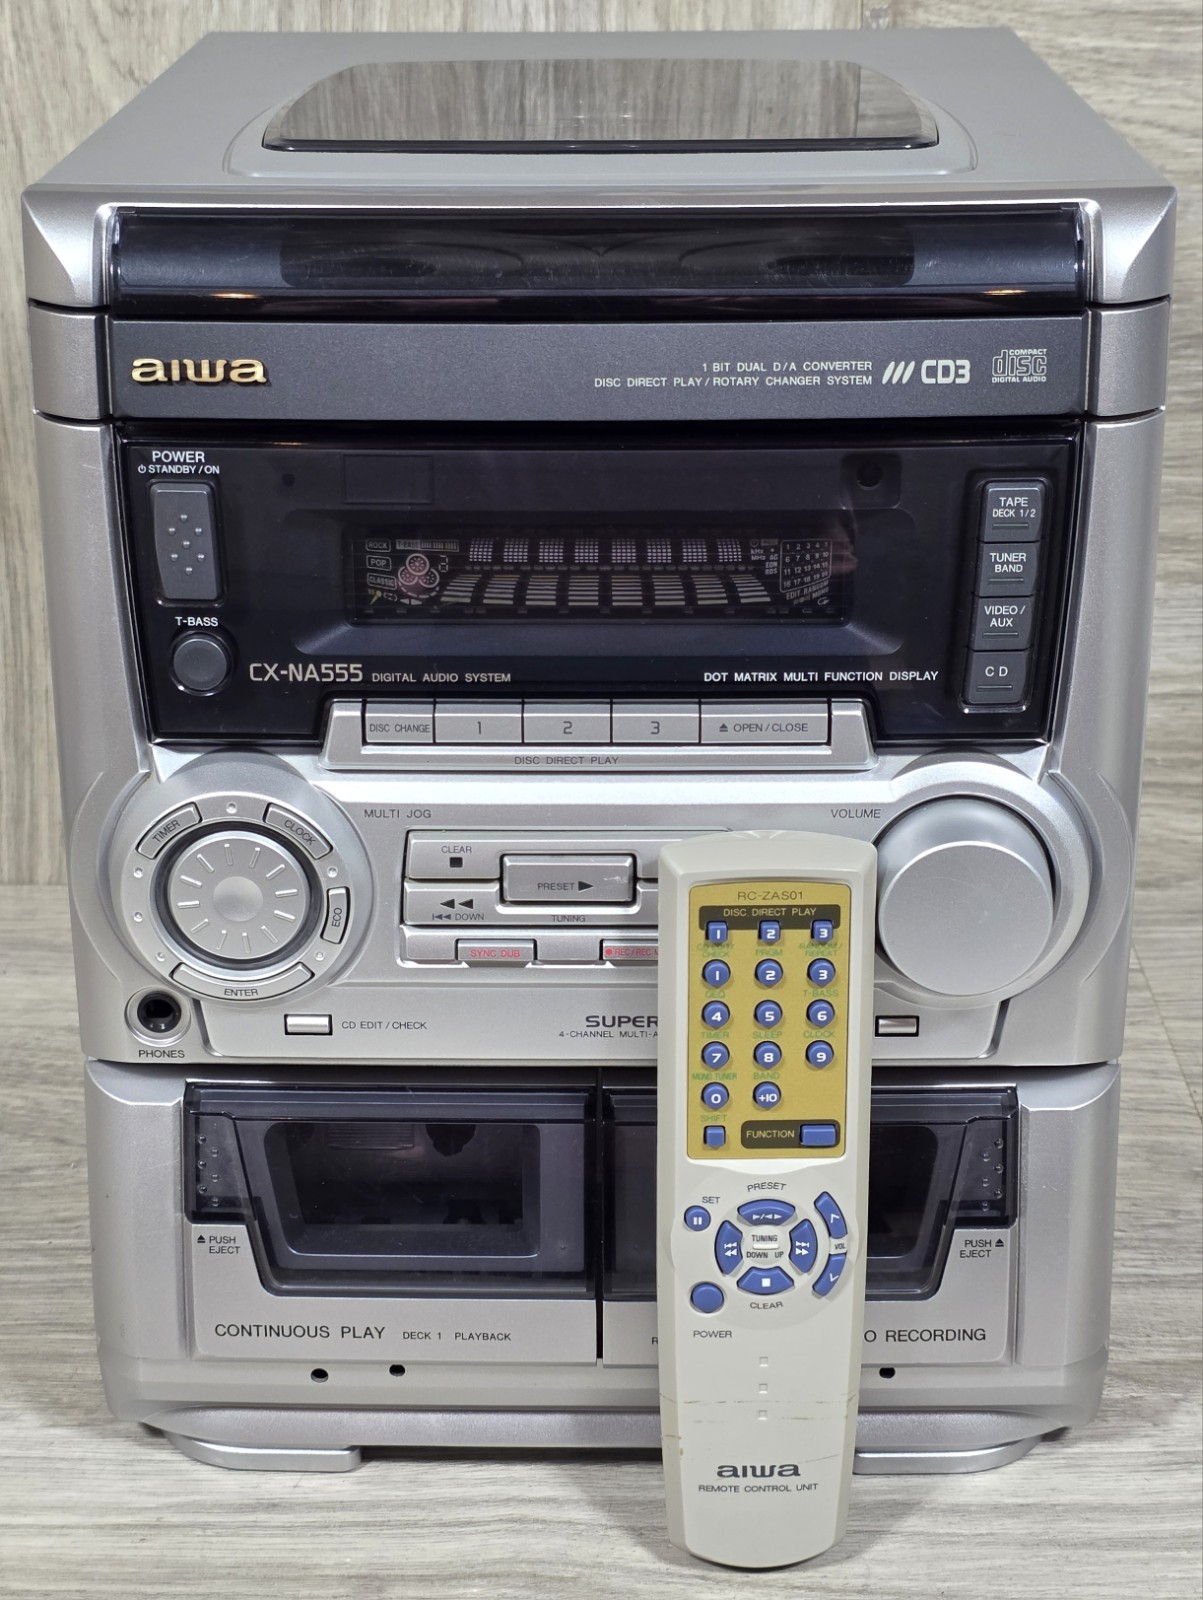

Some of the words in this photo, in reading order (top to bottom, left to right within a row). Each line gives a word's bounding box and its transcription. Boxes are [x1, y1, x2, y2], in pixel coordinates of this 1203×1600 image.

[1009, 348, 1048, 356] COMPACT
[131, 357, 268, 384] aiwa
[702, 362, 708, 373] 1
[712, 362, 731, 373] BIT
[736, 362, 767, 372] DUAL
[802, 361, 873, 372] CONVERTER
[920, 359, 971, 385] CD3
[594, 377, 621, 388] DISC
[626, 377, 668, 387] DIRECT
[765, 376, 821, 387] CHANGER
[826, 375, 873, 386] SYSTEM
[991, 376, 1021, 384] DIGITAL
[1022, 375, 1047, 383] AUDIO
[152, 450, 205, 464] POWER
[999, 496, 1029, 508] TAPE
[992, 508, 1016, 518] DECK
[1019, 508, 1037, 518] 1/2
[370, 558, 387, 567] POP
[989, 552, 1027, 563] TUNER
[994, 564, 1023, 573] BAND
[369, 576, 395, 587] CLASSIC
[174, 616, 219, 627] T-BASS
[989, 617, 1013, 628] AUX
[249, 662, 363, 682] CX-NA555
[371, 672, 417, 683] DIGITAL
[422, 672, 459, 683] AUDIO
[464, 672, 511, 683] SYSTEM
[704, 671, 729, 682] DOT
[734, 671, 779, 682] MATRIX
[783, 671, 819, 682] MULTI
[824, 671, 883, 682] FUNCTION
[889, 670, 939, 682] DISPLAY
[369, 723, 391, 733] DISC
[394, 722, 431, 733] CHANGE
[476, 721, 482, 736] 1
[562, 721, 573, 736] 2
[650, 721, 661, 735] 3
[514, 755, 541, 766] DISC
[546, 755, 585, 766] DIRECT
[590, 755, 620, 766] PLAY
[364, 809, 400, 819] MULTI
[406, 809, 432, 819] JOG
[830, 808, 881, 819] VOLUME
[152, 819, 181, 844] TIMER
[284, 819, 316, 846] CLOCK
[441, 845, 473, 854] CLEAR
[537, 882, 575, 891] PRESET
[737, 890, 804, 901] RC-ZAS01
[454, 912, 485, 921] DOWN
[723, 908, 747, 917] DISC
[751, 908, 787, 917] DIRECT
[791, 907, 817, 916] PLAY
[331, 907, 342, 928] ECO
[551, 914, 586, 923] TUNING
[766, 929, 776, 939] 2
[819, 928, 828, 938] 3
[470, 949, 496, 958] SYNC
[500, 949, 521, 958] DUB
[702, 950, 730, 958] CHECK
[805, 949, 837, 957] REPEAT
[765, 970, 776, 981] 2
[818, 970, 828, 980] 3
[223, 987, 259, 997] ENTER
[803, 989, 839, 998] T-BASS
[585, 1014, 658, 1028] SUPER
[711, 1011, 722, 1022] 4
[765, 1011, 775, 1022] 5
[817, 1010, 828, 1021] 6
[341, 1021, 357, 1030] CD
[558, 1030, 614, 1038] 4-CHANNEL
[701, 1031, 730, 1039] TIMER
[752, 1031, 783, 1039] SLEEP
[803, 1030, 836, 1038] CLOCK
[138, 1049, 185, 1059] PHONES
[711, 1053, 722, 1064] 7
[764, 1052, 774, 1063] 8
[816, 1052, 827, 1062] 9
[692, 1072, 712, 1080] MONO
[714, 1072, 737, 1080] TUNER
[753, 1072, 780, 1080] BAND
[758, 1093, 778, 1103] +10
[700, 1114, 727, 1123] SHIFT
[746, 1130, 795, 1139] FUNCTION
[747, 1182, 787, 1193] PRESET
[702, 1196, 721, 1204] SET
[209, 1235, 237, 1244] PUSH
[964, 1239, 992, 1248] PUSH
[209, 1245, 241, 1254] EJECT
[959, 1249, 992, 1259] EJECT
[746, 1251, 769, 1259] DOWN
[774, 1251, 785, 1259] UP
[750, 1301, 784, 1310] CLEAR
[214, 1323, 331, 1340] CONTINUOUS
[340, 1325, 386, 1340] PLAY
[402, 1331, 432, 1341] DECK
[437, 1331, 442, 1341] 1
[454, 1331, 512, 1342] PLAYBACK
[693, 1330, 733, 1338] POWER
[885, 1328, 986, 1343] RECORDING
[716, 1462, 801, 1479] aiwa
[698, 1484, 740, 1493] REMOTE
[744, 1484, 792, 1493] CONTROL
[796, 1483, 818, 1492] UNIT
